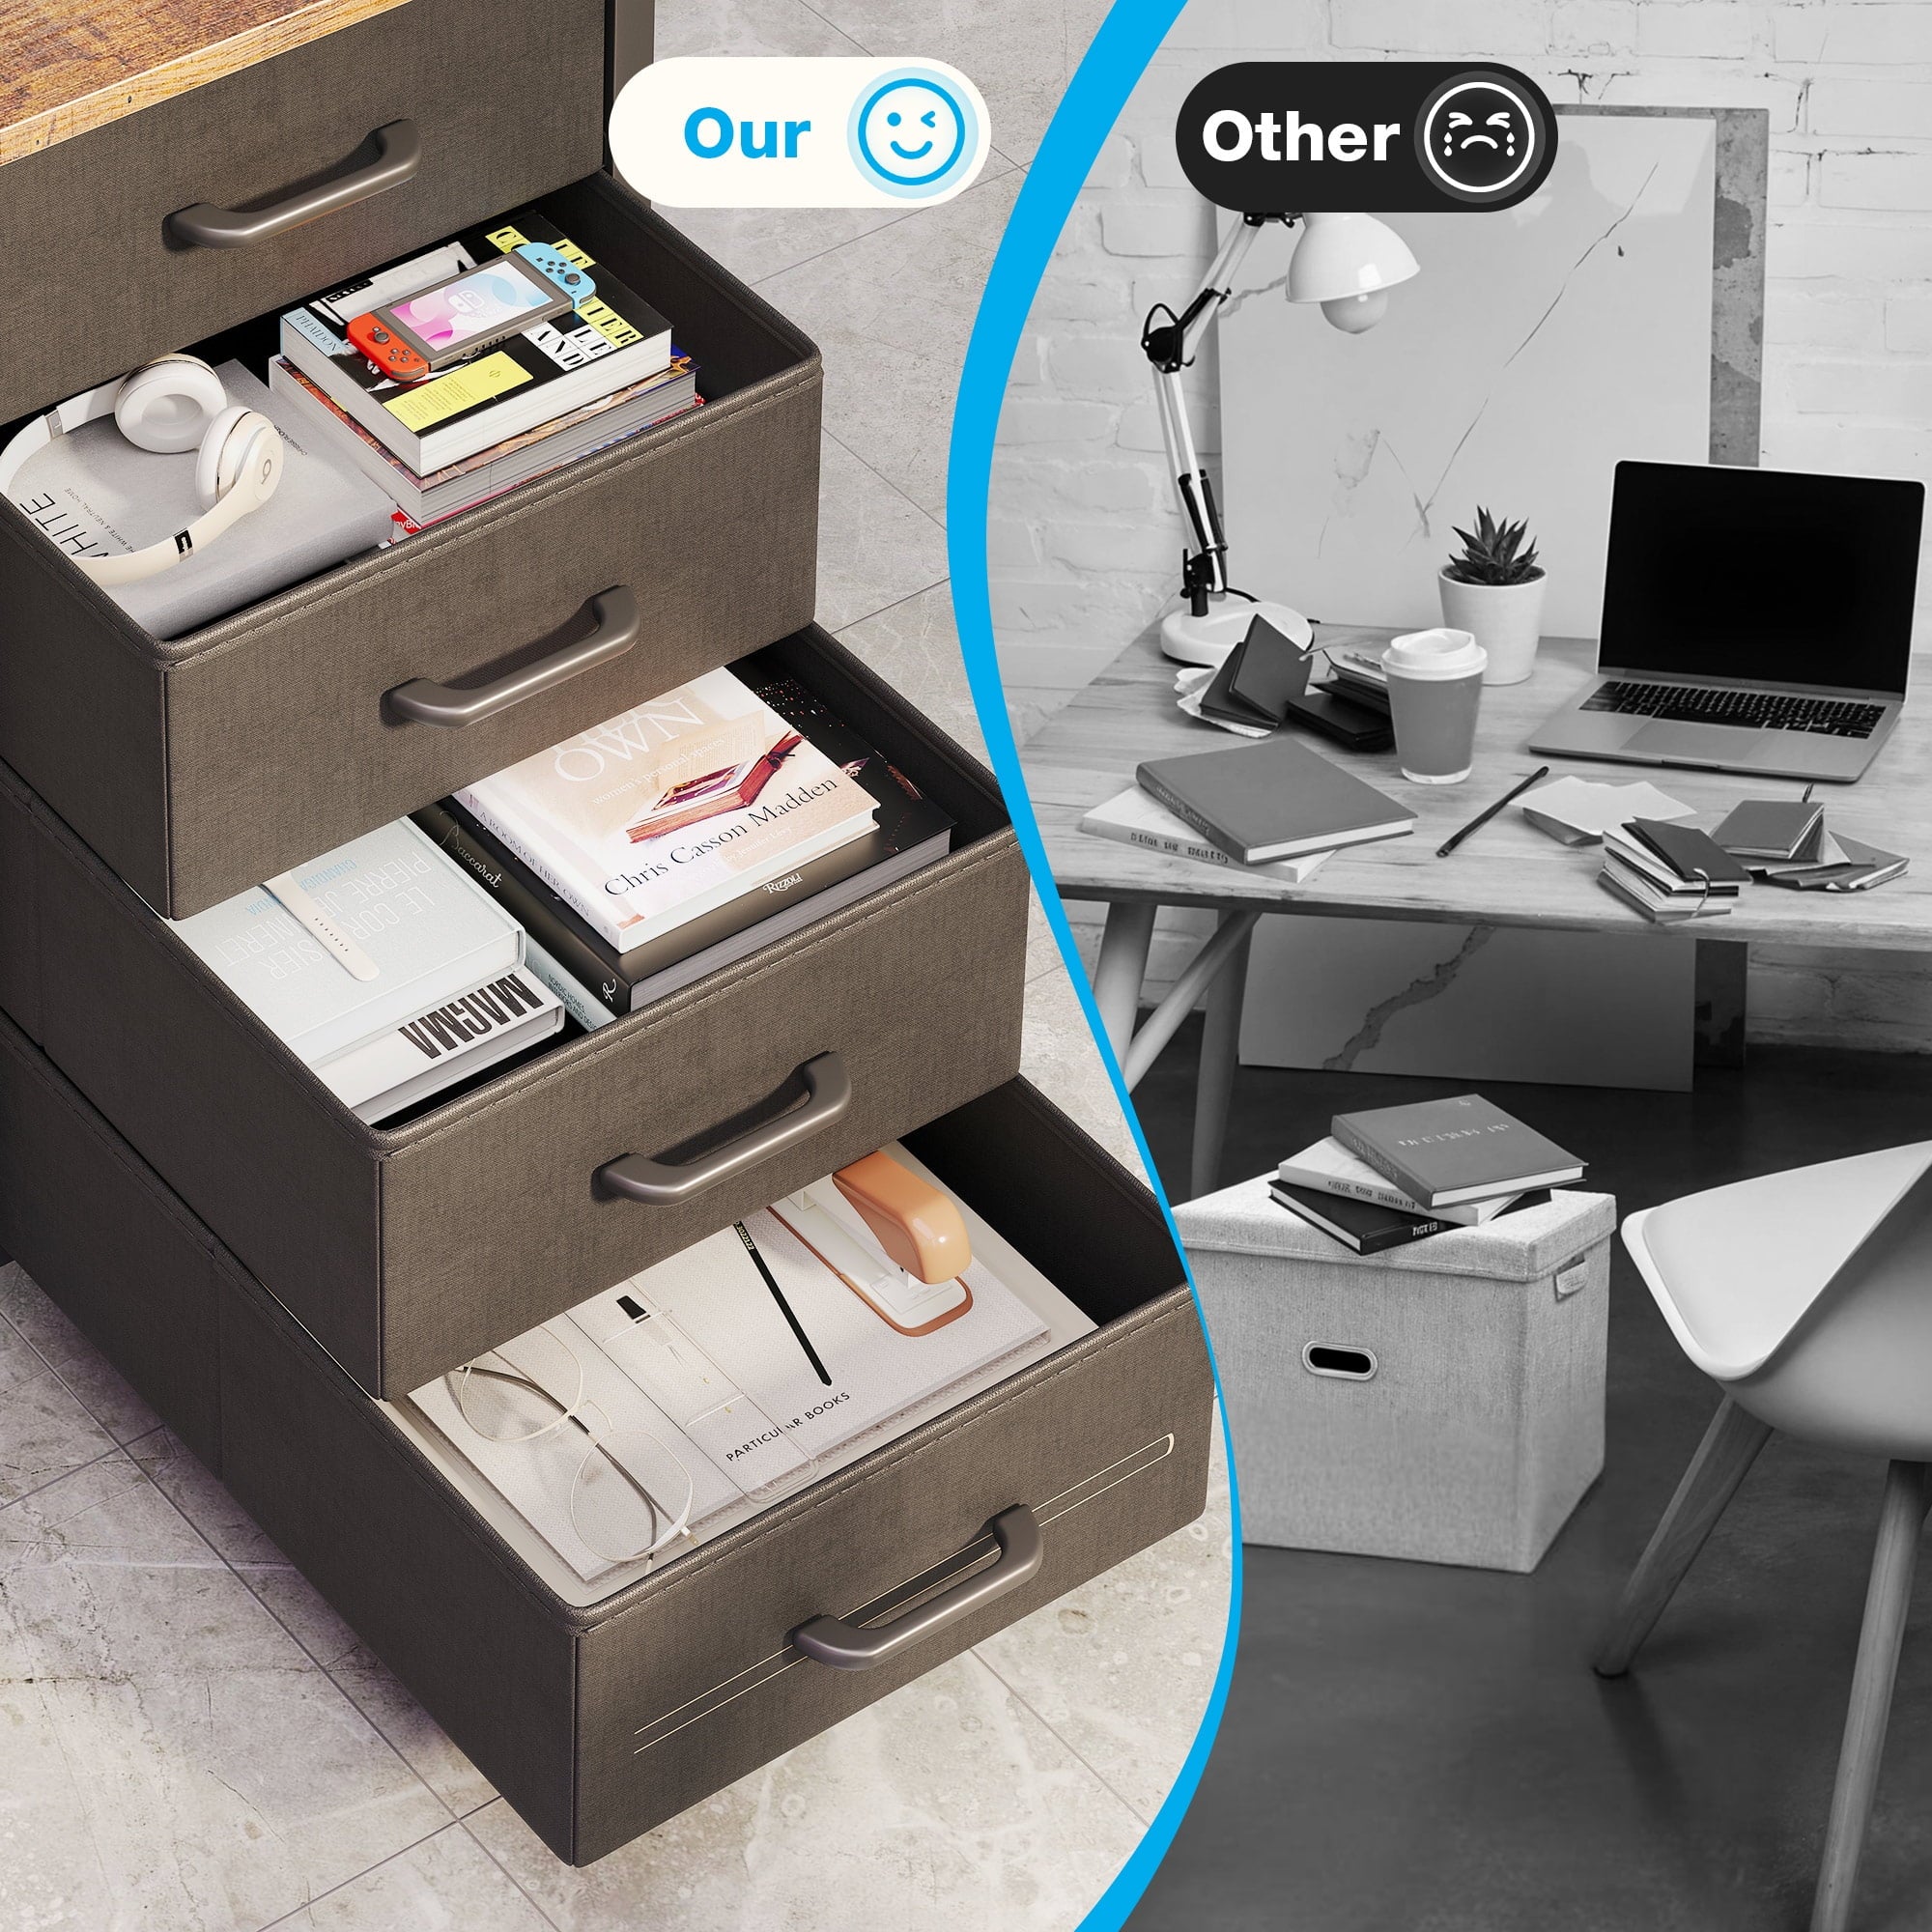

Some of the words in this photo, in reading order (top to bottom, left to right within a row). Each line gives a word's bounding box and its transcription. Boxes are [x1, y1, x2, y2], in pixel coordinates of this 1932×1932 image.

[296, 315, 341, 351] PHAIDON
[531, 329, 584, 365] AND
[19, 493, 109, 557] HITE
[554, 697, 704, 781] OWN
[592, 776, 642, 805] women's
[644, 753, 689, 783] personal
[691, 738, 725, 761] spaces
[440, 810, 502, 888] Baccarat
[489, 818, 523, 854] ROOM
[604, 861, 668, 895] Chris
[669, 824, 749, 865] Casson
[748, 780, 838, 827] Madden
[298, 859, 357, 891] CHANDIGA
[341, 852, 432, 904] PIERRE
[397, 973, 544, 1060] MAGMA
[804, 1392, 850, 1421] BOOKS
